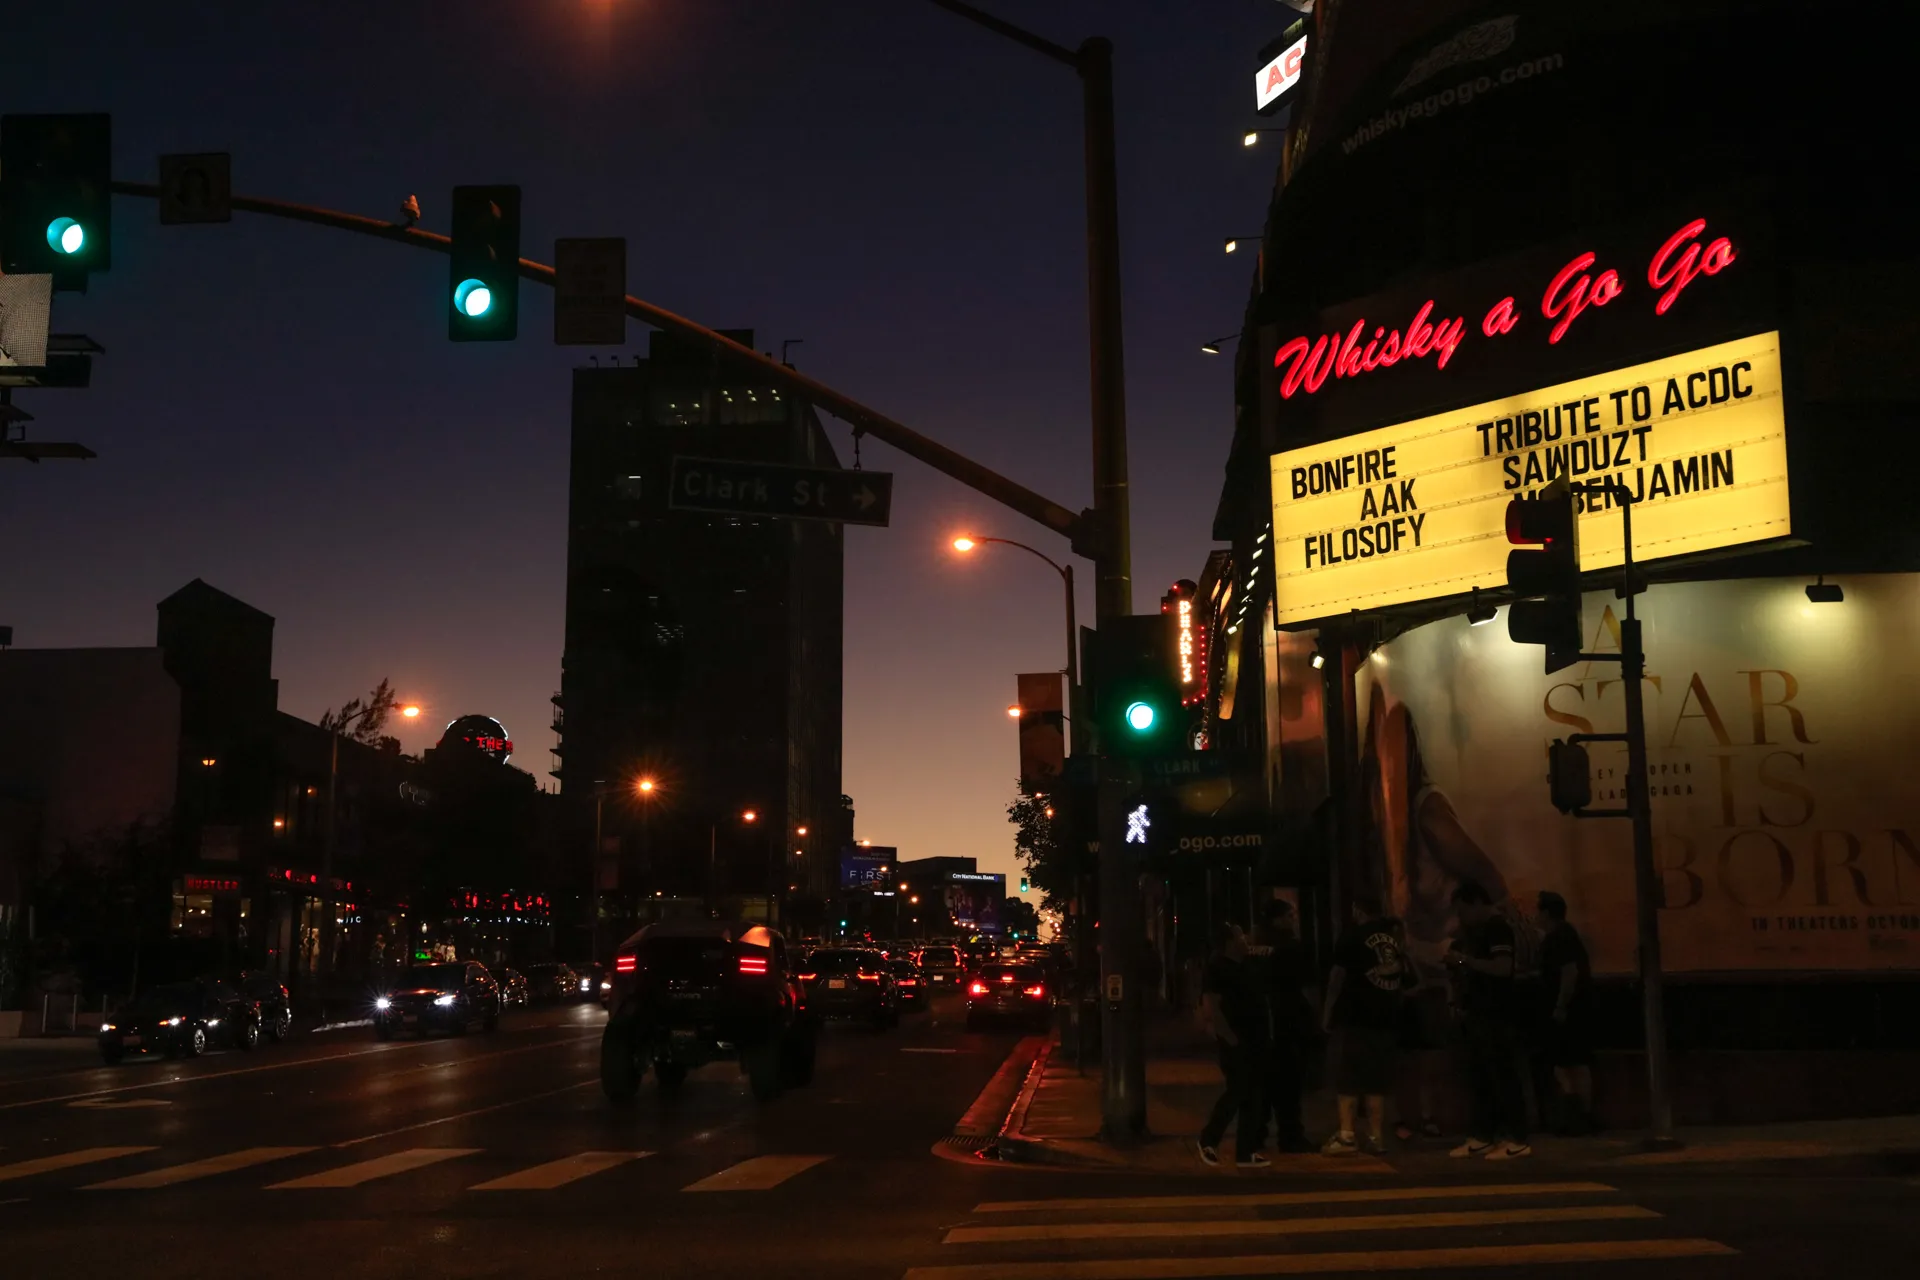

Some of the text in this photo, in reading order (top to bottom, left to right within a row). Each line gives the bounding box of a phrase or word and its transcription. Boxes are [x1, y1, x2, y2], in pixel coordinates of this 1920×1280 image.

[1265, 41, 1307, 94] AC
[1341, 52, 1564, 156] whiskyagogo.com
[1274, 218, 1738, 399] Whisky a Go Go
[1476, 361, 1753, 456] TRIBUTE TO ACDC
[684, 470, 829, 507] Clark St
[1291, 446, 1397, 500] BONFIRE
[1503, 425, 1653, 490] SAWDUZT
[1360, 478, 1418, 522] AAK
[1304, 514, 1426, 569] FILOSOFY
[1179, 600, 1192, 682] PEARLS
[1543, 669, 1819, 759] STAR
[1708, 750, 1816, 829] IS
[1777, 916, 1858, 930] THEATERS
